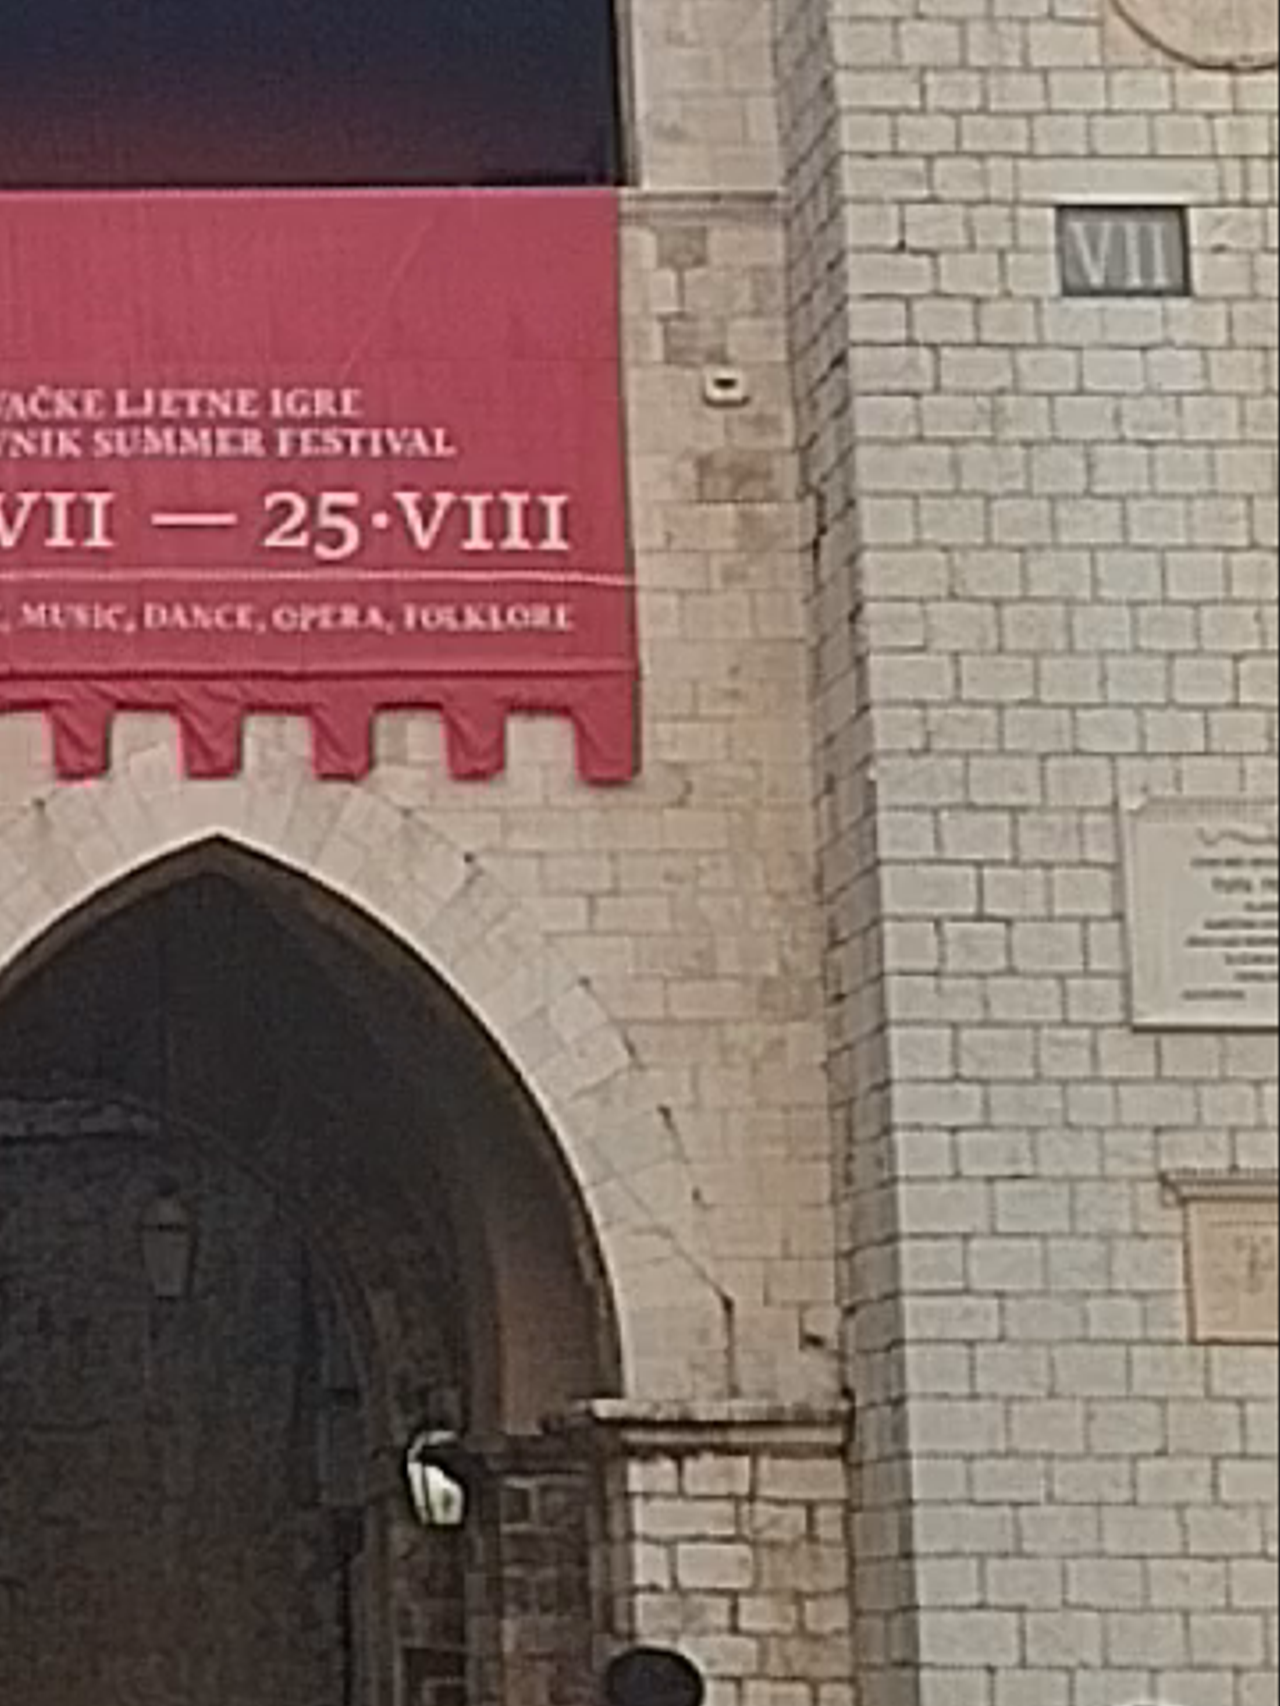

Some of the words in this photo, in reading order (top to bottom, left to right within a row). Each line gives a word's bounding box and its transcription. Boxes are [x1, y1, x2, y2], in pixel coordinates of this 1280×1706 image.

[1067, 220, 1171, 287] VII
[115, 387, 260, 419] LJETNE
[271, 387, 364, 419] IGRE
[93, 428, 266, 459] SUMMER
[277, 427, 457, 458] FESTIVAL
[21, 601, 136, 634] MUSIC,
[143, 602, 267, 634] DANCE,
[271, 602, 394, 635] OPERA,
[403, 603, 574, 632] FOLKLORE
